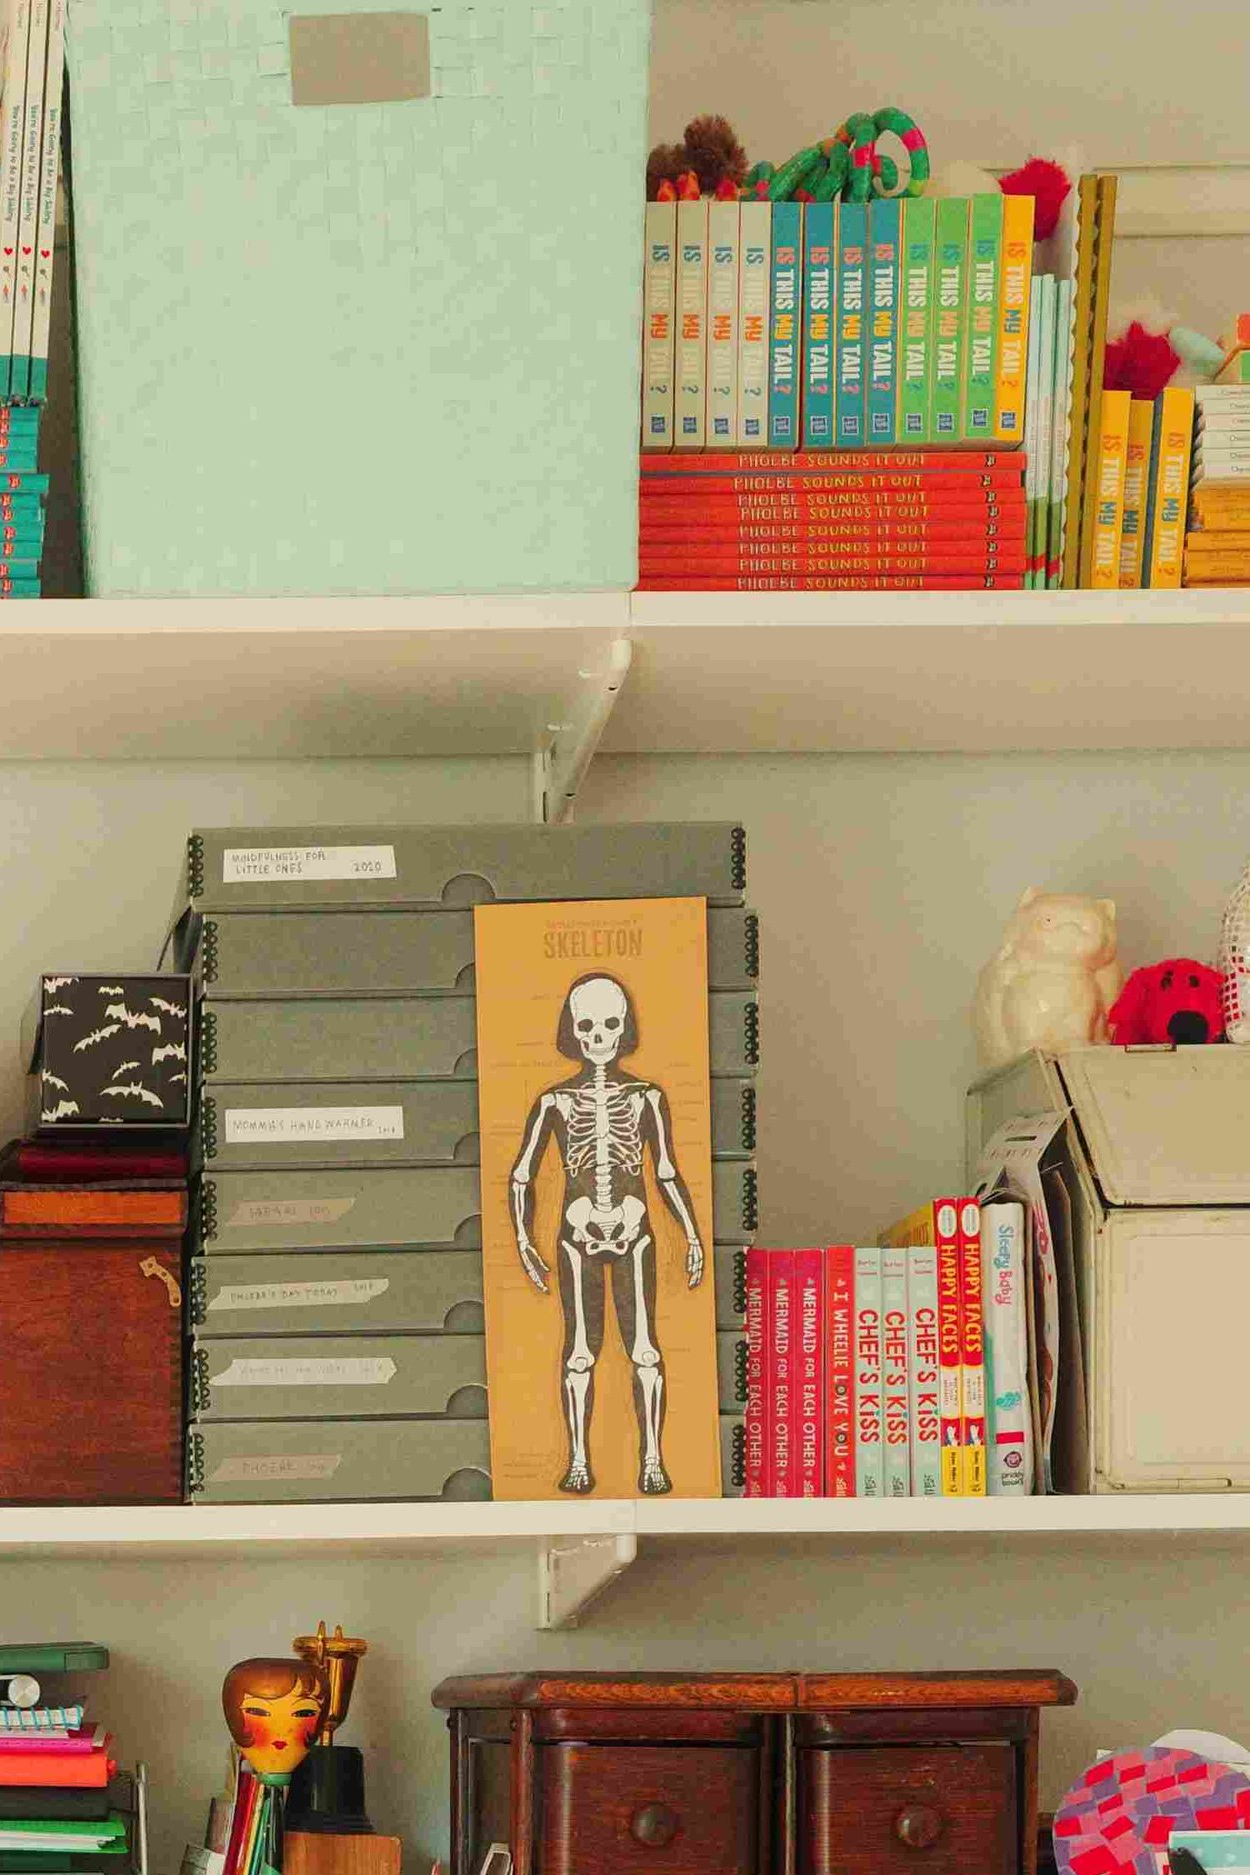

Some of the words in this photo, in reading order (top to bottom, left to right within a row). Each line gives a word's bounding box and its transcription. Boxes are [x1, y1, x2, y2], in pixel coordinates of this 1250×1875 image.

[774, 246, 795, 265] IS
[875, 244, 894, 262] IS
[773, 267, 796, 310] THIS
[874, 265, 894, 307] THIS
[770, 343, 795, 394] TAIL?
[869, 342, 892, 393] TAIL?
[733, 474, 796, 489] PHOEBE
[802, 475, 866, 489] SOUNDS
[871, 474, 886, 488] IT
[890, 474, 922, 488] OUT
[236, 864, 270, 875] LITTLE
[543, 929, 643, 959] SKELETON
[992, 1224, 1014, 1268] Sleepy
[940, 1245, 956, 1297] HAPPY
[993, 1271, 1013, 1305] Baby
[775, 1289, 788, 1353] MERMAID
[834, 1308, 849, 1369] WHEELIE
[941, 1303, 958, 1354] FACES
[858, 1309, 882, 1384] CHEF'S
[776, 1359, 787, 1379] FOR
[775, 1384, 788, 1418] EACH
[833, 1375, 848, 1415] LOVE
[775, 1423, 788, 1468] OTHER
[833, 1424, 848, 1456] YOU
